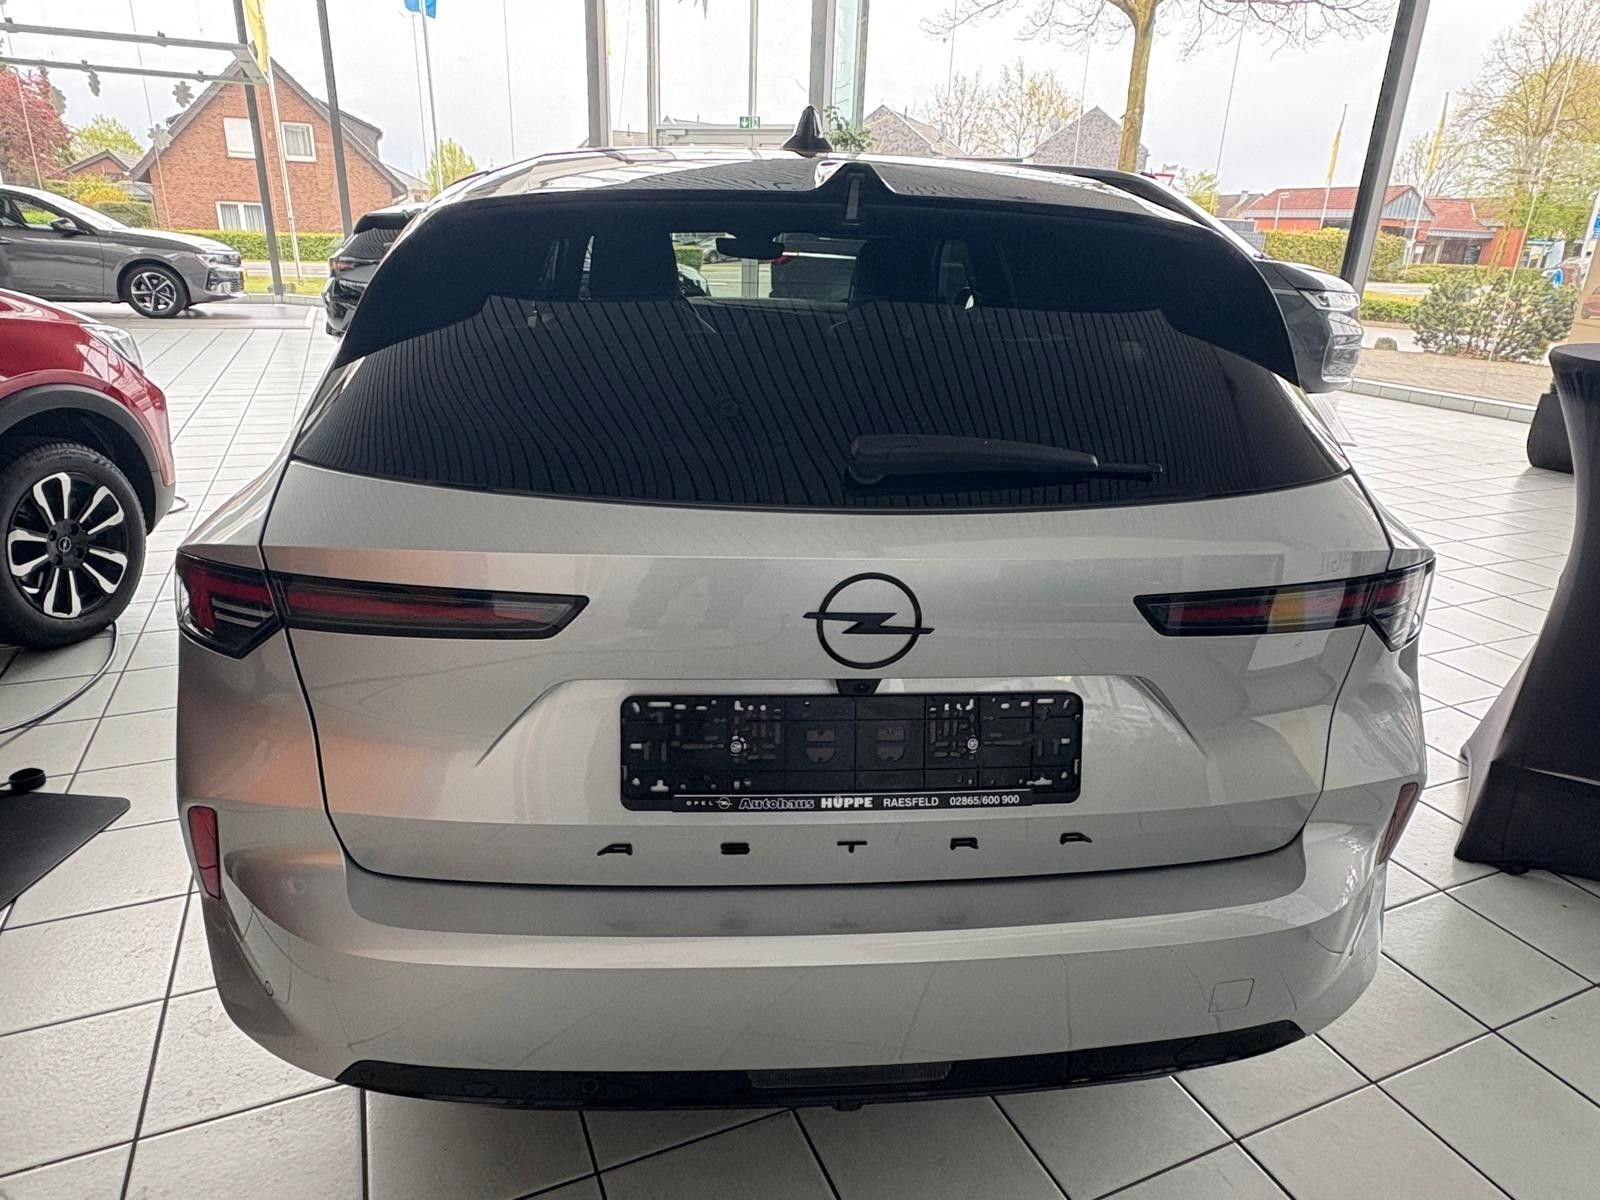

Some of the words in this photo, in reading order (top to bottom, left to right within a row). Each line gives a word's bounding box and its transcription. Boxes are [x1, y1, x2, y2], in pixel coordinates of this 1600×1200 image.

[739, 797, 815, 810] Autohaus
[821, 796, 873, 808] HÜPPE
[884, 797, 939, 808] RAESFELD
[950, 796, 1000, 805] 02865/600
[1002, 795, 1019, 804] 900
[598, 832, 1092, 856] ASTRA
